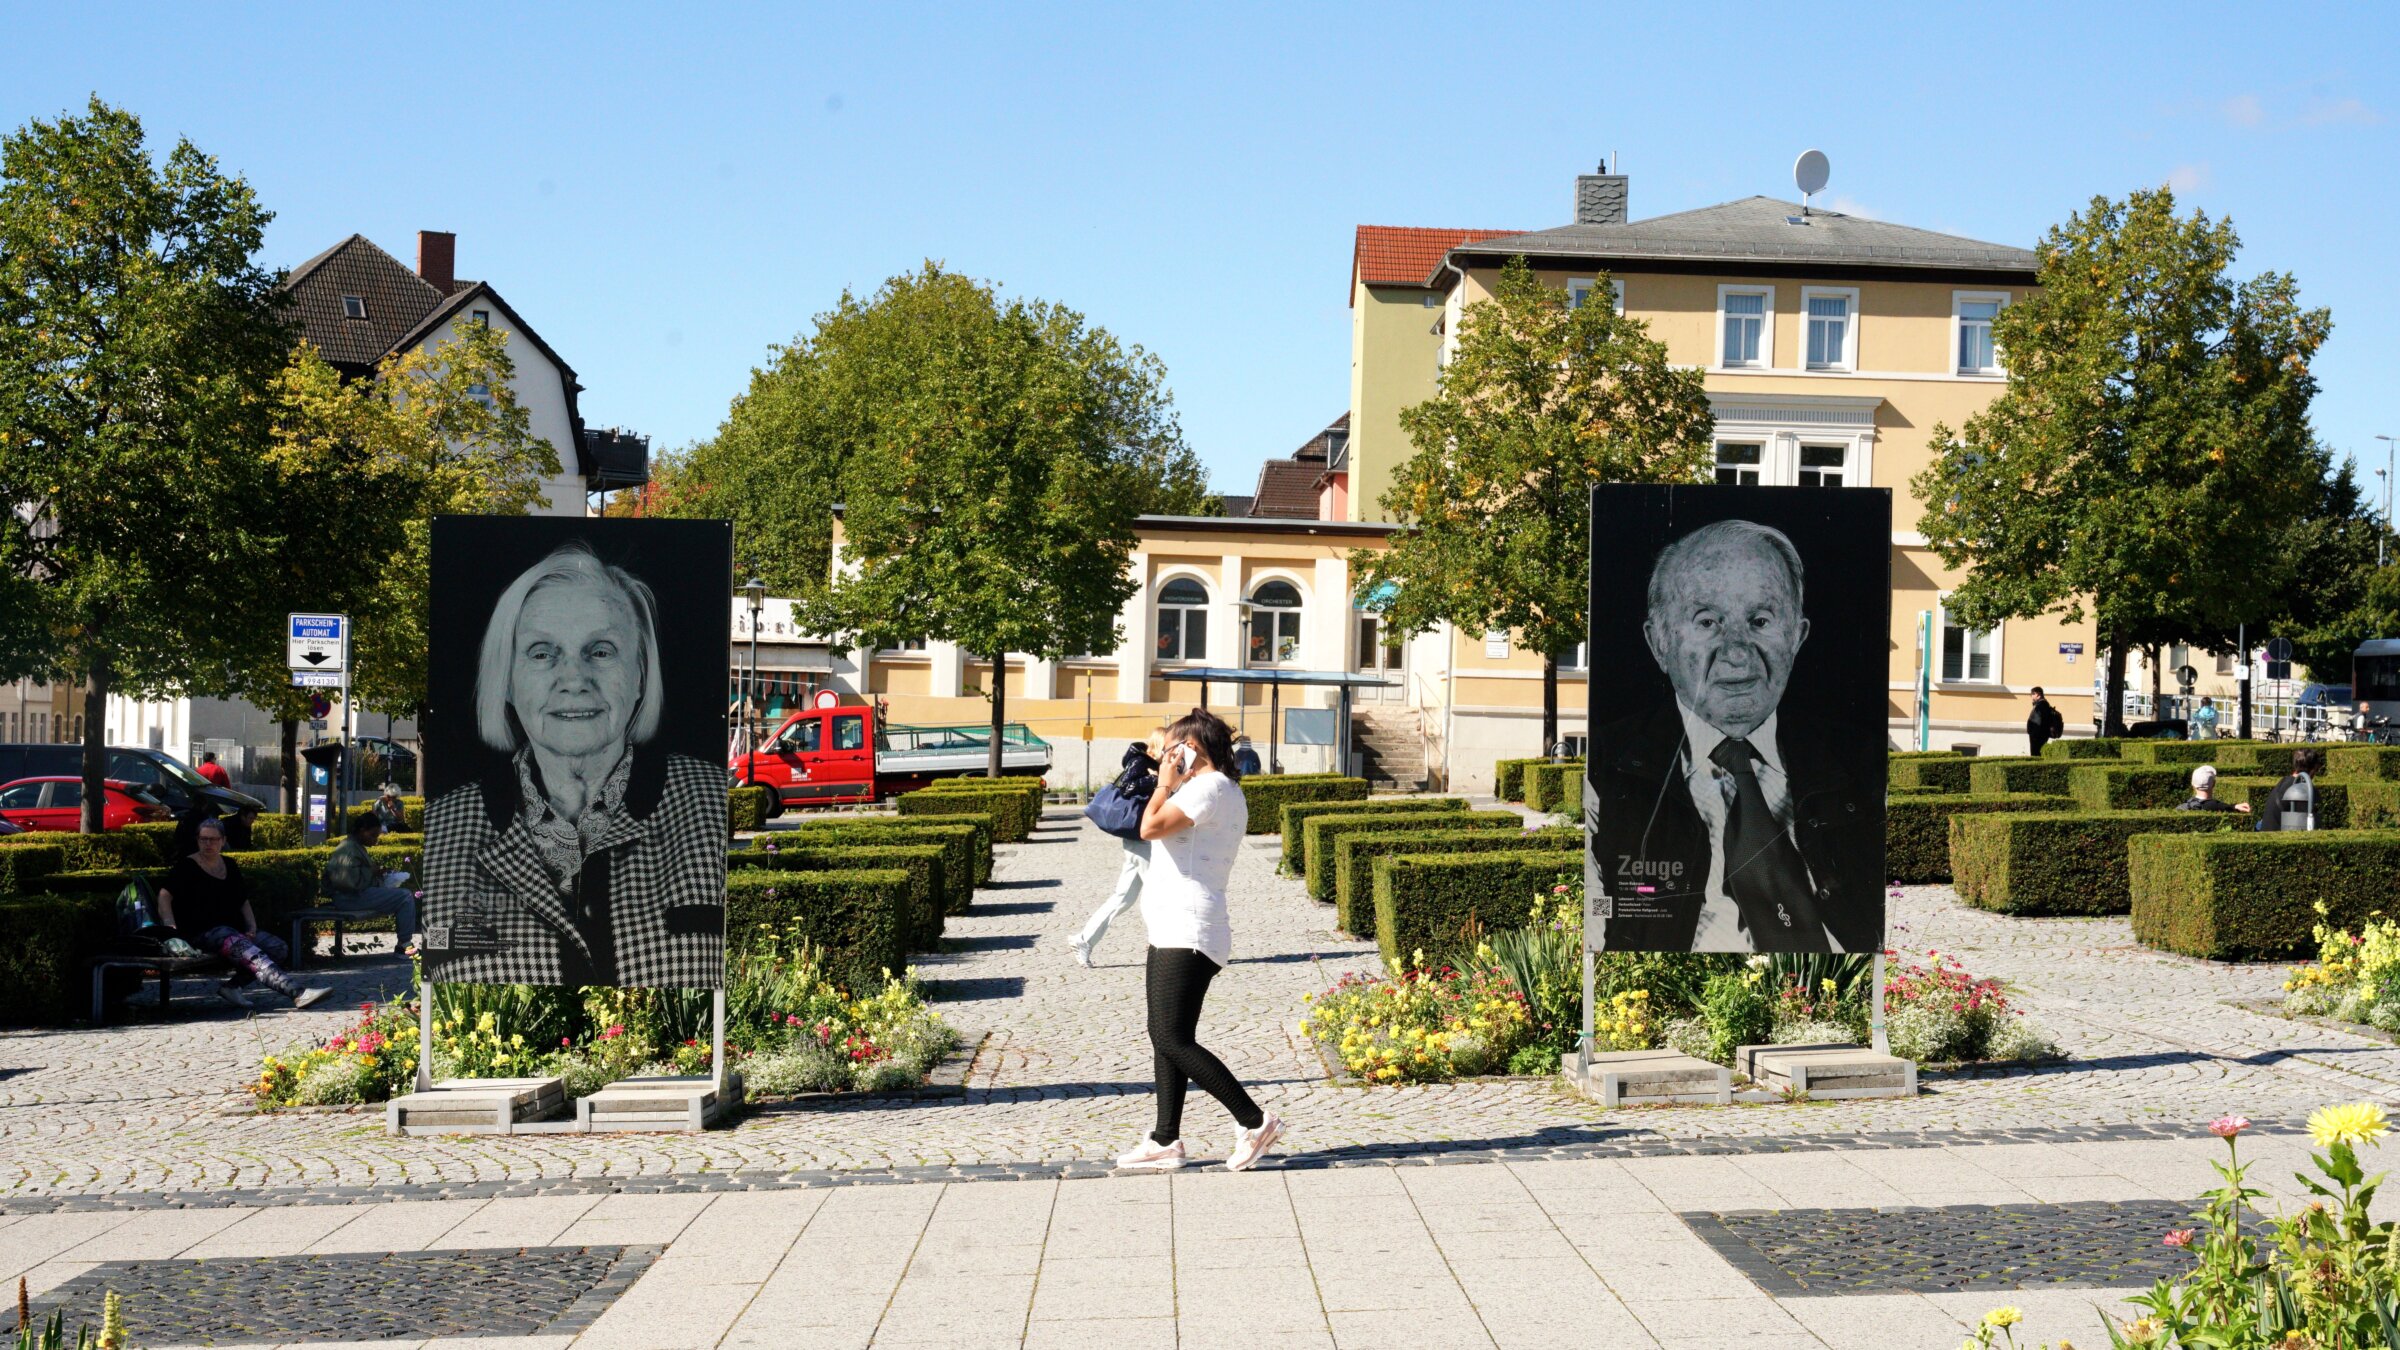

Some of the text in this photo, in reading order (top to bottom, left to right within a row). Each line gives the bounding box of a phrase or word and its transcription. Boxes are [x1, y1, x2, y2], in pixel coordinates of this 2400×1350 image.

[295, 618, 337, 628] PARKSCHEIN-
[302, 628, 330, 637] AUTOMAT
[307, 678, 336, 686] 994130
[1617, 854, 1684, 881] Zeuge
